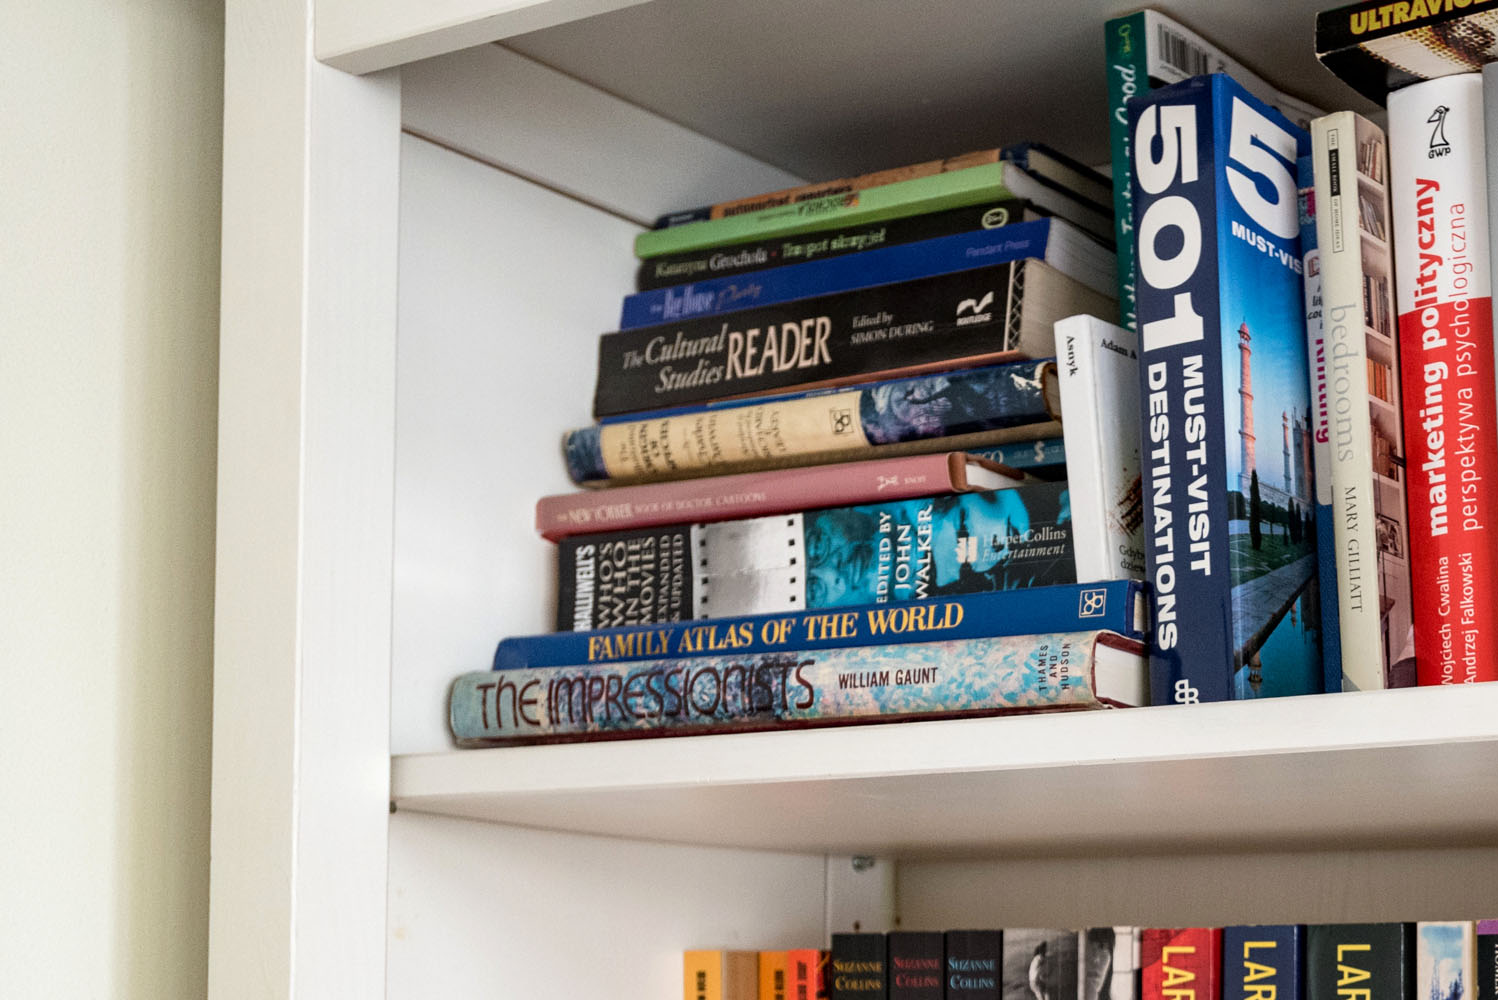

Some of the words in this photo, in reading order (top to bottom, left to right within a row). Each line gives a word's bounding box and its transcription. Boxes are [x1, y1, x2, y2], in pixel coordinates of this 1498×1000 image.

[1135, 103, 1205, 354] 501
[1415, 178, 1440, 351] polityczny
[1448, 202, 1475, 378] psychologiczna
[645, 324, 729, 365] Cultural
[726, 316, 832, 379] READER
[655, 365, 724, 392] Studies
[1182, 355, 1211, 576] MUST-VISIT
[1420, 361, 1449, 536] marketing
[1453, 387, 1483, 531] perspektywa
[983, 527, 1067, 549] HarperCollins
[1148, 362, 1178, 651] DESTINATIONS
[895, 524, 912, 588] JOHN
[917, 505, 933, 599] WALKER
[983, 544, 1064, 563] Entertainment
[1437, 557, 1450, 616] Cwalina
[1458, 553, 1474, 624] Falkowski
[588, 631, 677, 661] FAMILY
[678, 623, 753, 652] ATLAS
[762, 618, 796, 643] OF
[803, 613, 858, 641] THE
[867, 603, 964, 634] WORLD
[839, 671, 889, 689] WILLIAM
[896, 667, 938, 686] GAUNT
[1039, 645, 1048, 691] THAMES
[1062, 642, 1070, 690] HUDSON
